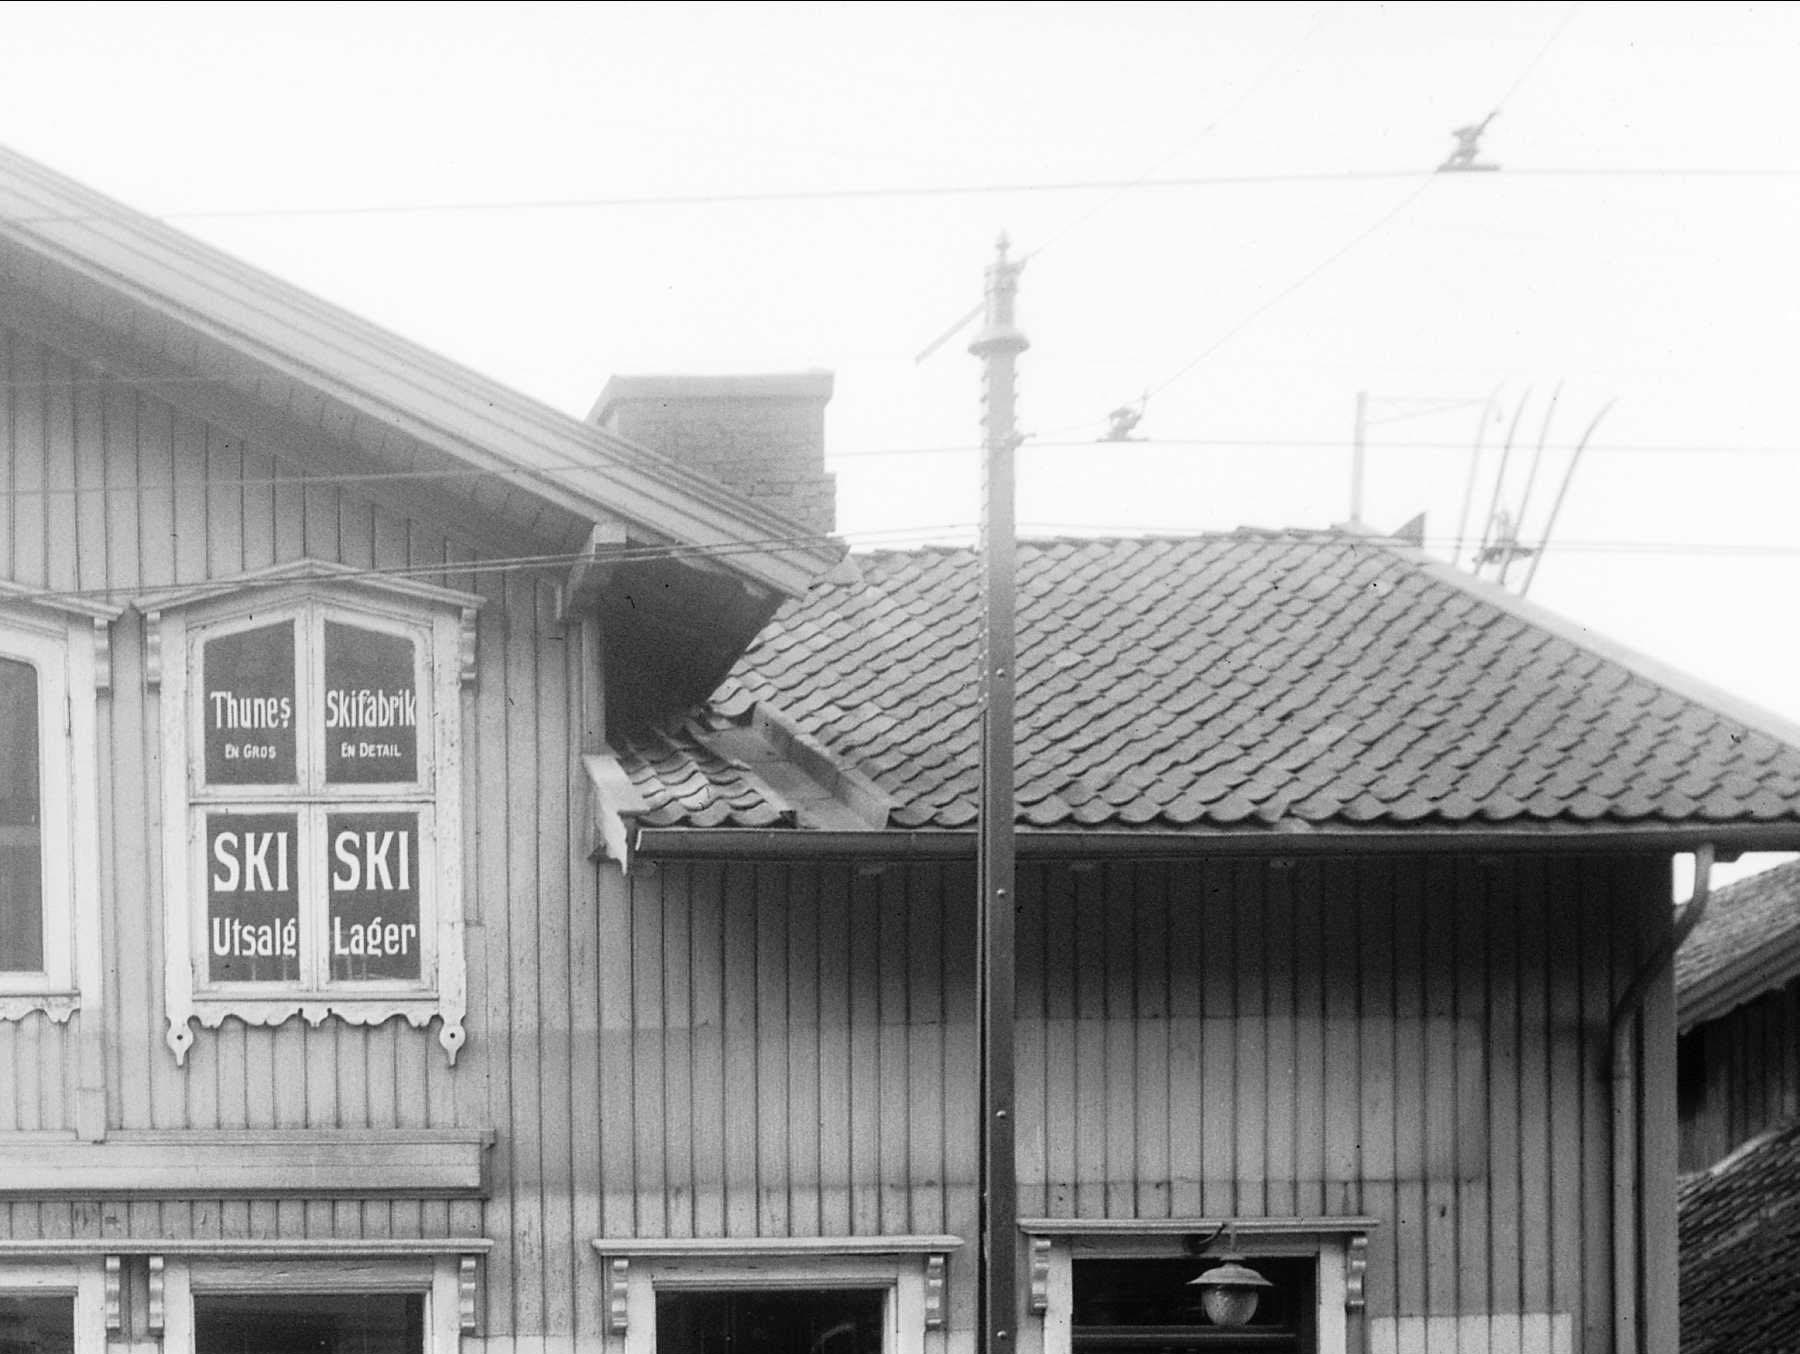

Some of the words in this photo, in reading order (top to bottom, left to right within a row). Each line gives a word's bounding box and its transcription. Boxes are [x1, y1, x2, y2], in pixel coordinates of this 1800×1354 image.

[210, 691, 291, 729] Thunes
[325, 690, 416, 729] Skifabrik
[213, 831, 289, 892] SKI
[333, 831, 410, 891] SKI
[212, 917, 297, 958] Utsalg
[333, 917, 416, 958] Lager
